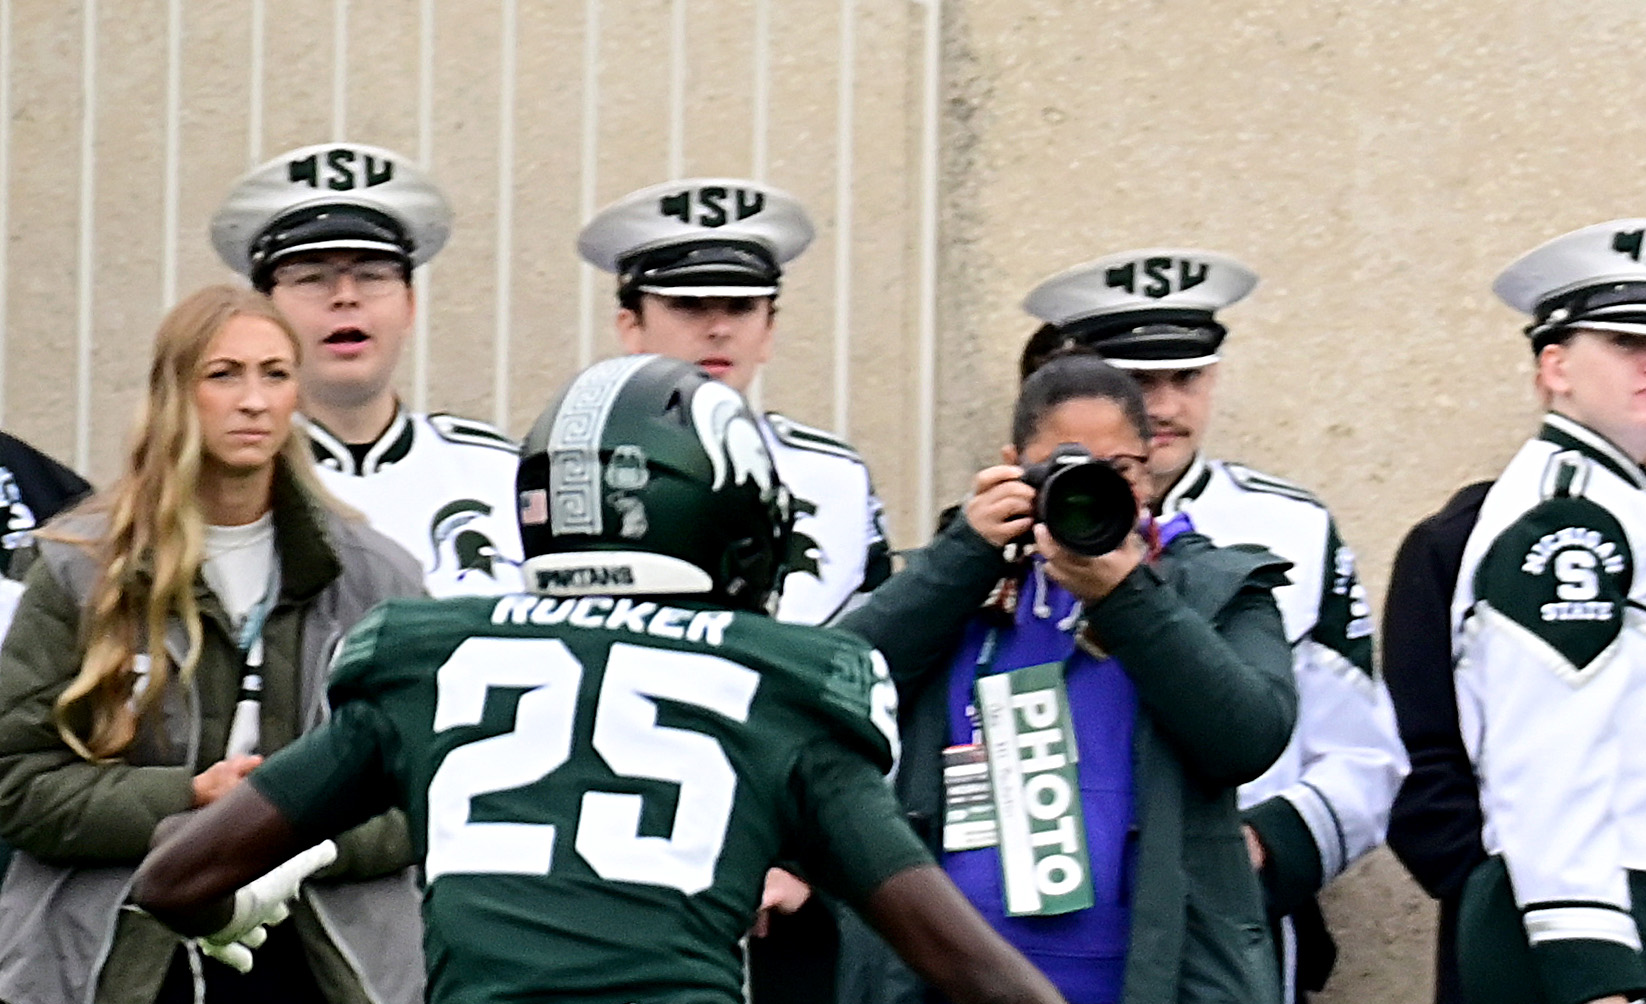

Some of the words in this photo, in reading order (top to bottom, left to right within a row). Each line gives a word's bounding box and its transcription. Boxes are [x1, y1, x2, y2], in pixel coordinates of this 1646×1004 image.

[490, 594, 735, 646] RUCKER
[1553, 549, 1600, 601] S
[425, 636, 762, 896] 25
[1010, 688, 1084, 896] PHOTO
